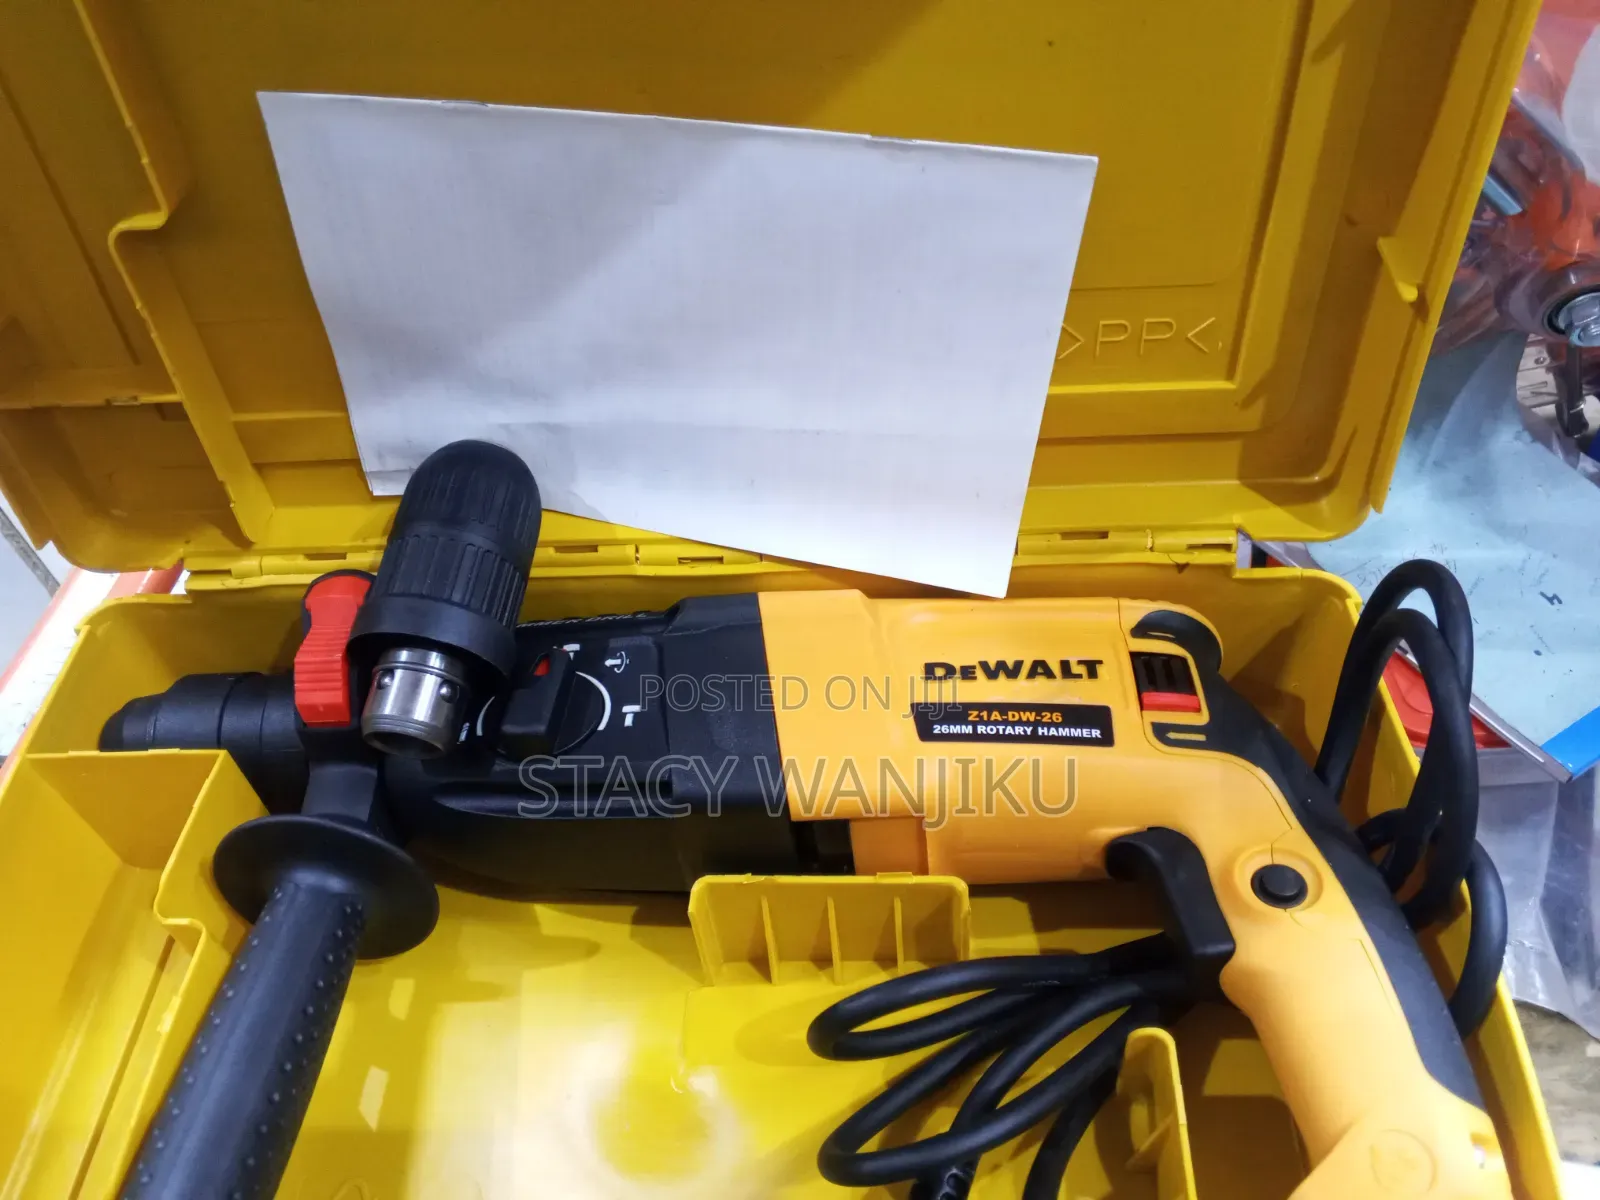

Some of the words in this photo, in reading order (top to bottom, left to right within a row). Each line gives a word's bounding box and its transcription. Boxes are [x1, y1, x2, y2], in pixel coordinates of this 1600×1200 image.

[967, 710, 1063, 724] Z1A-DW-26
[932, 724, 973, 735] 26MM
[977, 725, 1032, 736] ROTARY
[1038, 726, 1102, 739] HAMMER
